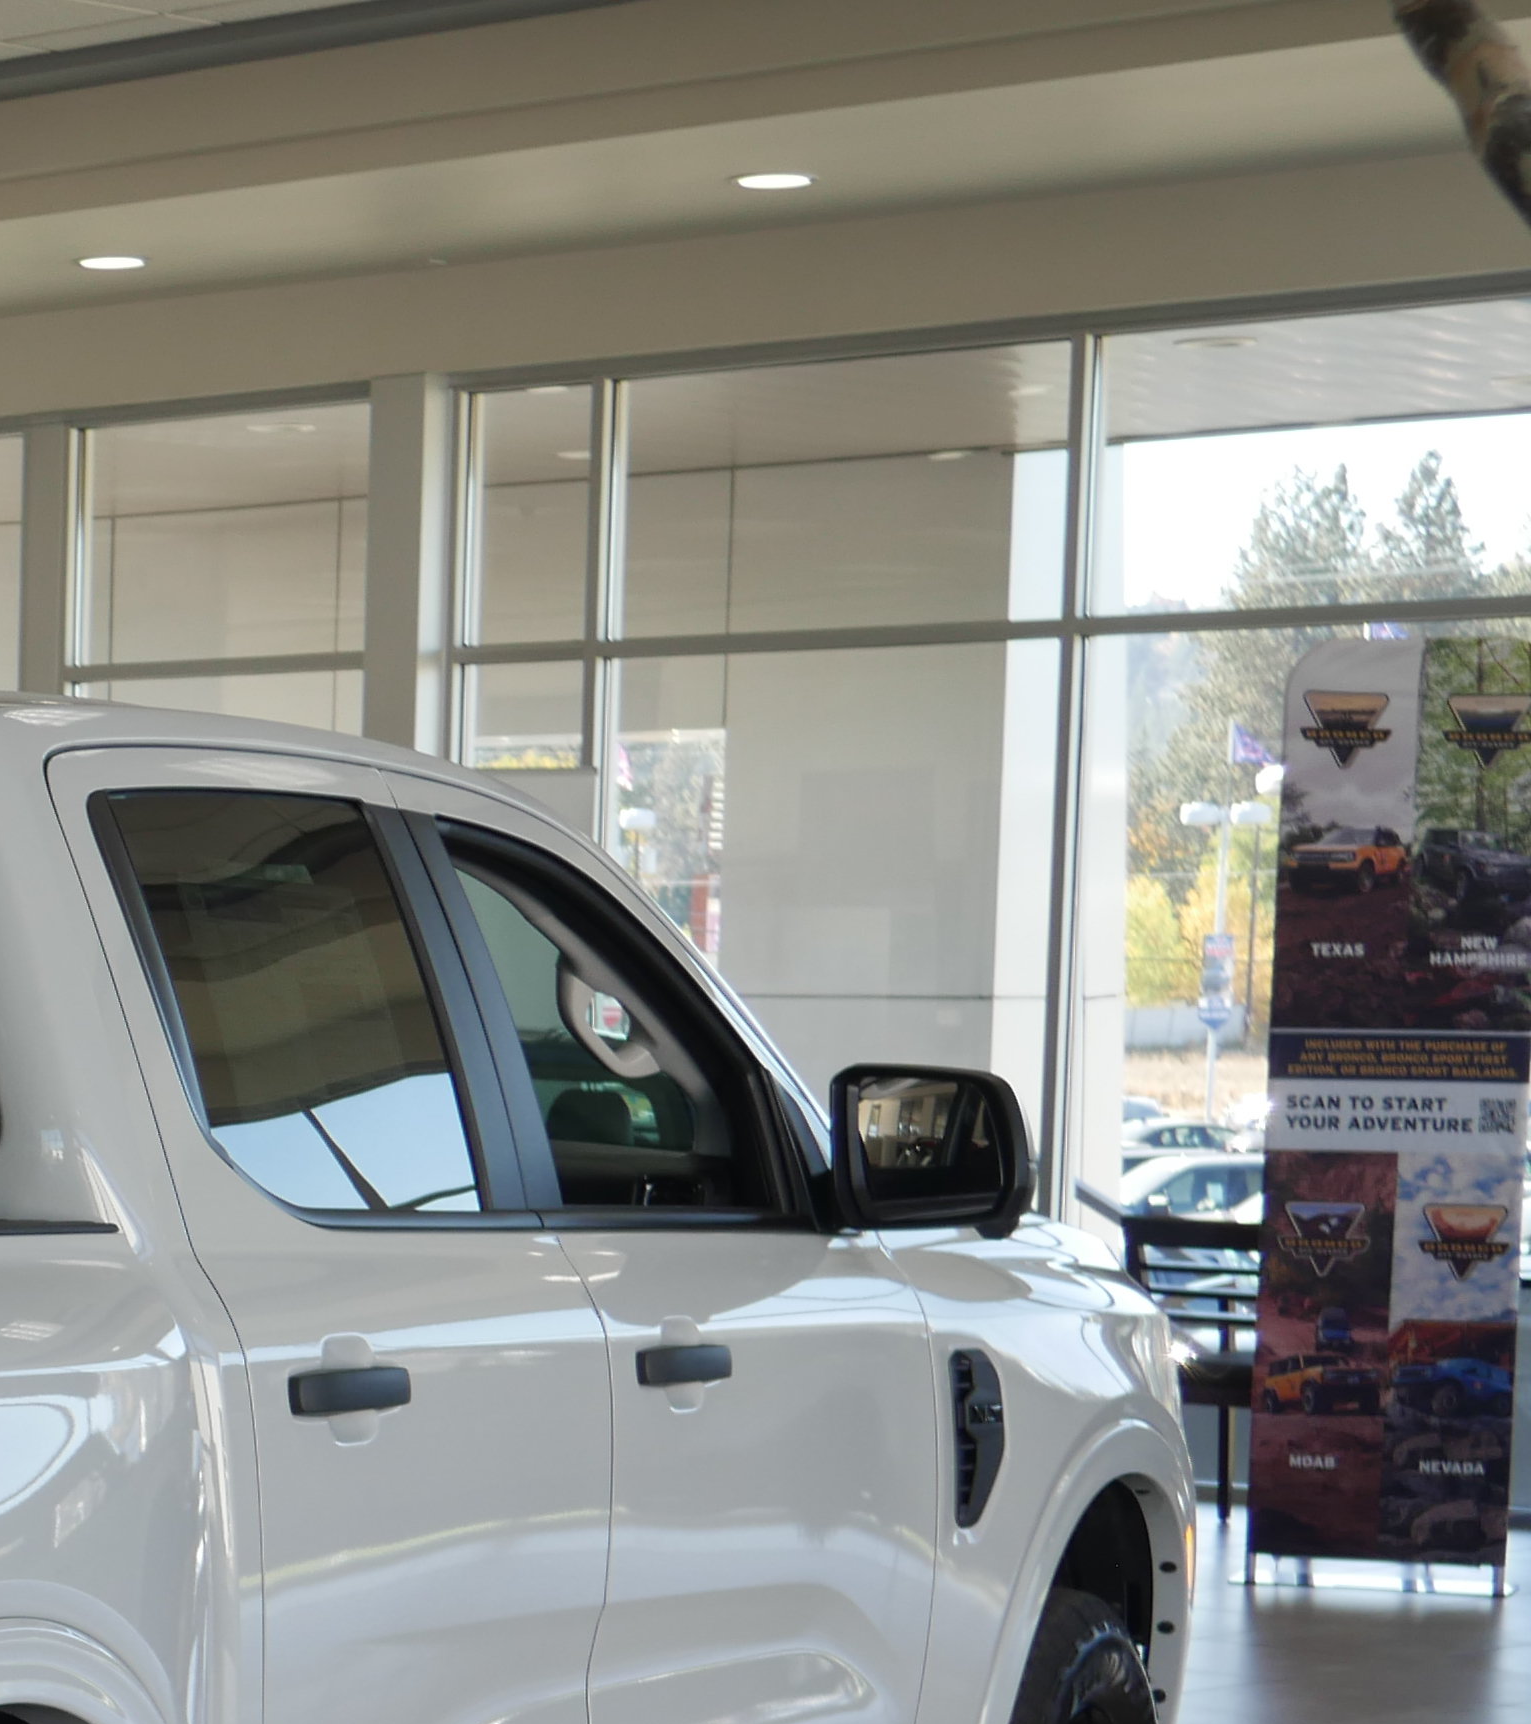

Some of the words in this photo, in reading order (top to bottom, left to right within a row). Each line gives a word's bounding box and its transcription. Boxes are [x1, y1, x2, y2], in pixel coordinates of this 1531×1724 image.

[1310, 941, 1365, 958] TEXAS
[1460, 935, 1499, 950] NEW
[1429, 951, 1528, 967] HAMPSHIRE
[1305, 1039, 1362, 1049] INCLUDED
[1366, 1039, 1395, 1050] WITH
[1399, 1040, 1420, 1051] THE
[1425, 1040, 1488, 1052] PURCHASE
[1491, 1041, 1507, 1052] OF
[1300, 1052, 1323, 1062] ANY
[1381, 1053, 1429, 1064] BRONCO
[1432, 1054, 1470, 1065] SPORT
[1474, 1055, 1508, 1065] FIRST
[1341, 1065, 1356, 1075] OR
[1360, 1065, 1407, 1076] BRONCO
[1411, 1066, 1448, 1077] SPORT
[1287, 1095, 1341, 1111] SCAN
[1348, 1096, 1375, 1111] TO
[1382, 1097, 1447, 1112] START
[1286, 1115, 1341, 1131] YOUR
[1348, 1116, 1473, 1132] ADVENTURE
[1289, 1454, 1336, 1470] MOAB
[1419, 1460, 1484, 1476] NEVADA
